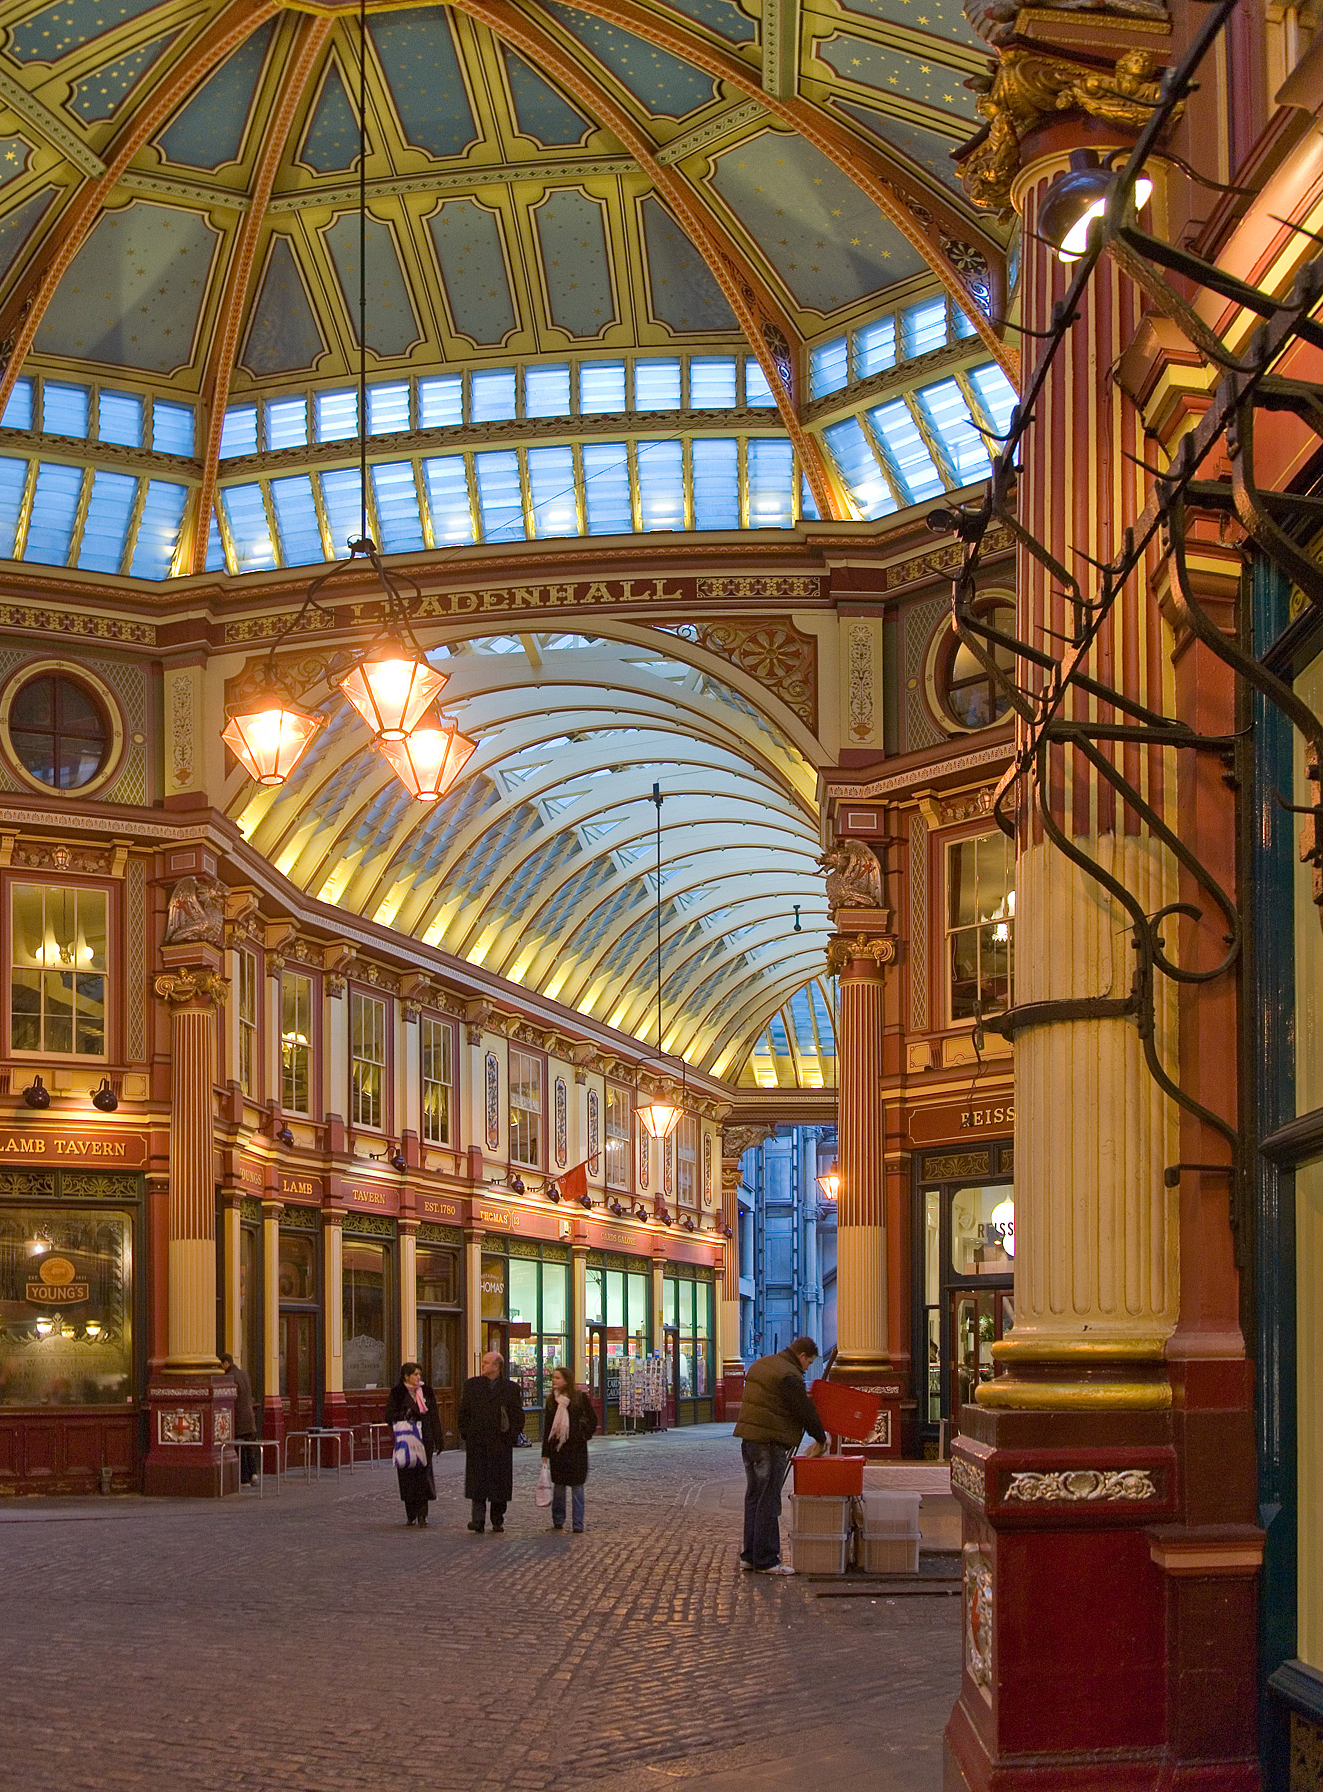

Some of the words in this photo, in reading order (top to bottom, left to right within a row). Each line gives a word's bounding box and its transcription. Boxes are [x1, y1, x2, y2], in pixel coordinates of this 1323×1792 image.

[350, 579, 683, 625] LEADENHALL
[961, 1107, 1015, 1128] REISS
[54, 1140, 126, 1156] TAVERN
[283, 1179, 313, 1195] LAMB
[352, 1189, 386, 1205] TAVERN
[978, 1222, 1014, 1239] REISS
[601, 1232, 617, 1244] CARDS
[618, 1234, 636, 1246] GALORE
[31, 1286, 84, 1300] YOUNG'S
[480, 1282, 504, 1294] HOMAS'
